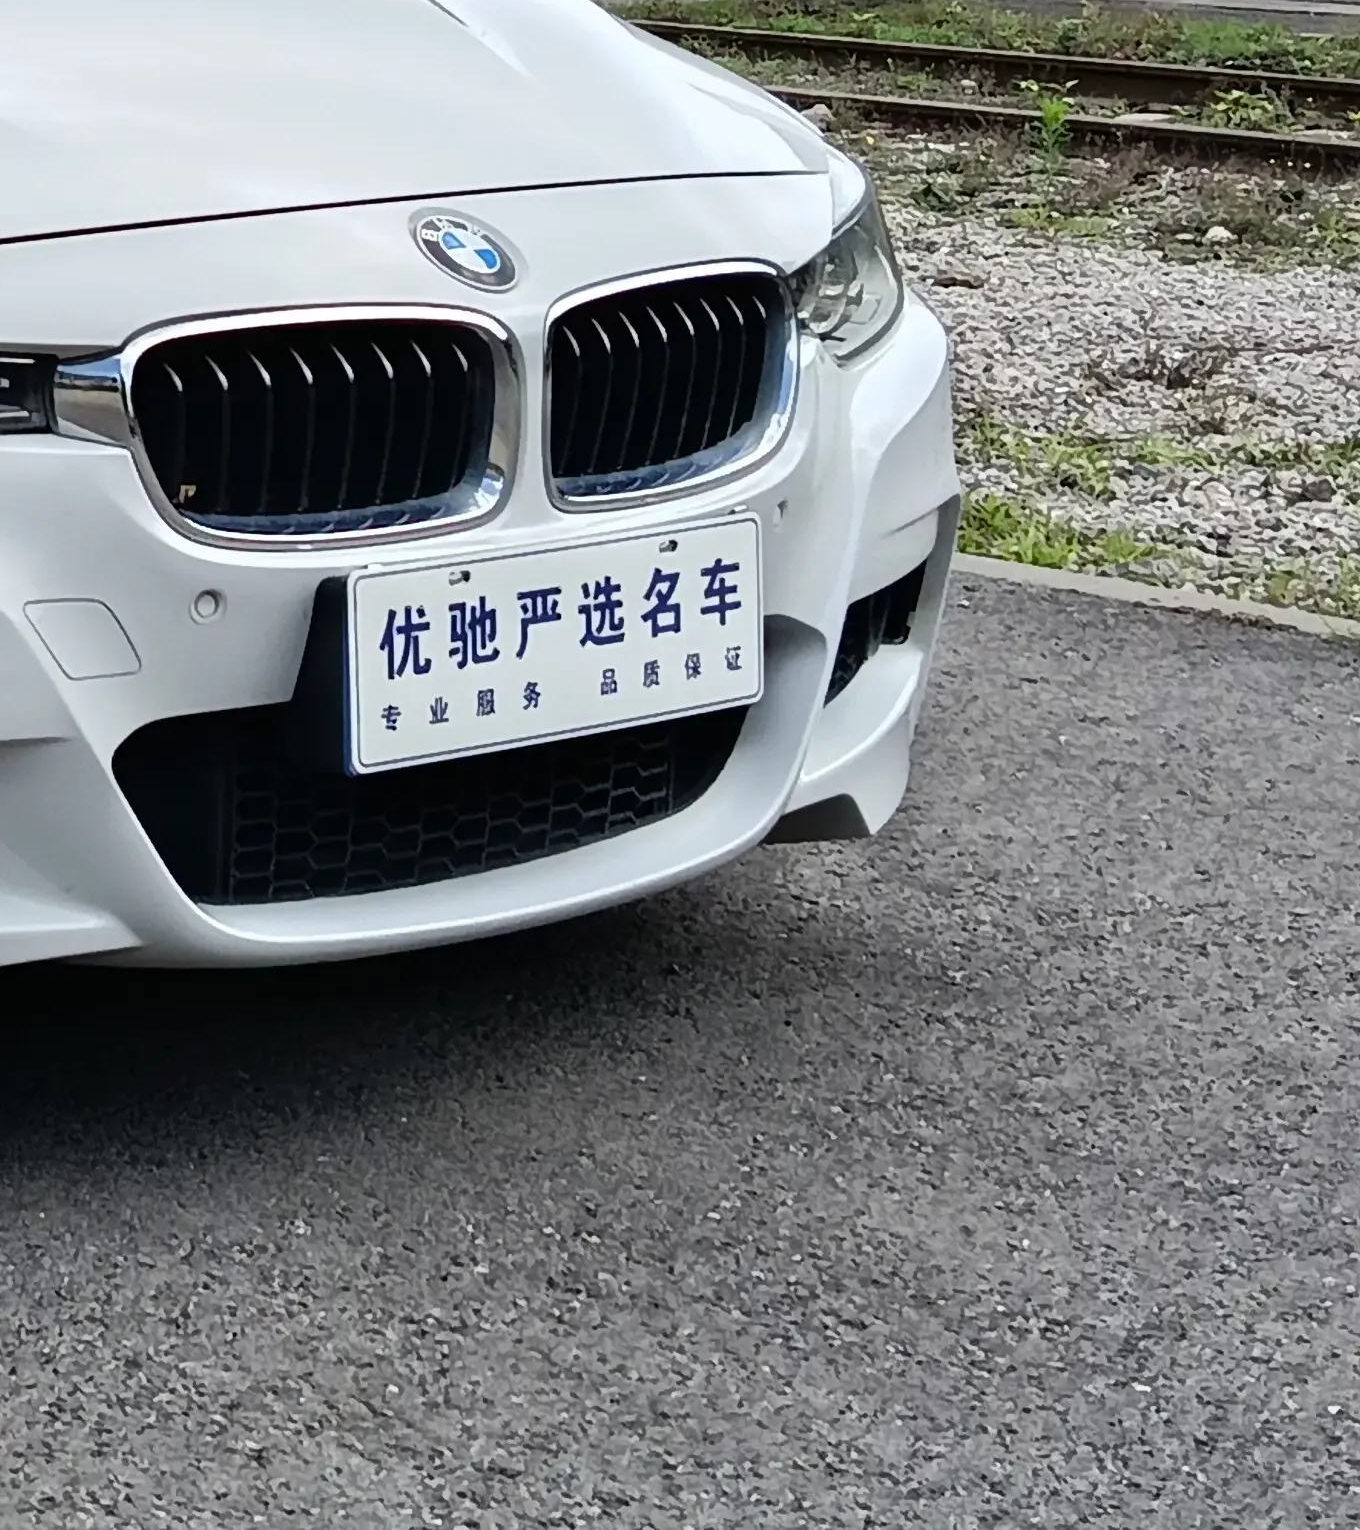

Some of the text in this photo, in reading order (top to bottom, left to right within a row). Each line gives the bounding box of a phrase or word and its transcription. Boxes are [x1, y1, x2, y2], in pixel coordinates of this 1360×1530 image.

[379, 558, 742, 680] 优驰严选名车
[380, 645, 742, 731] 专业服务 品质保证
